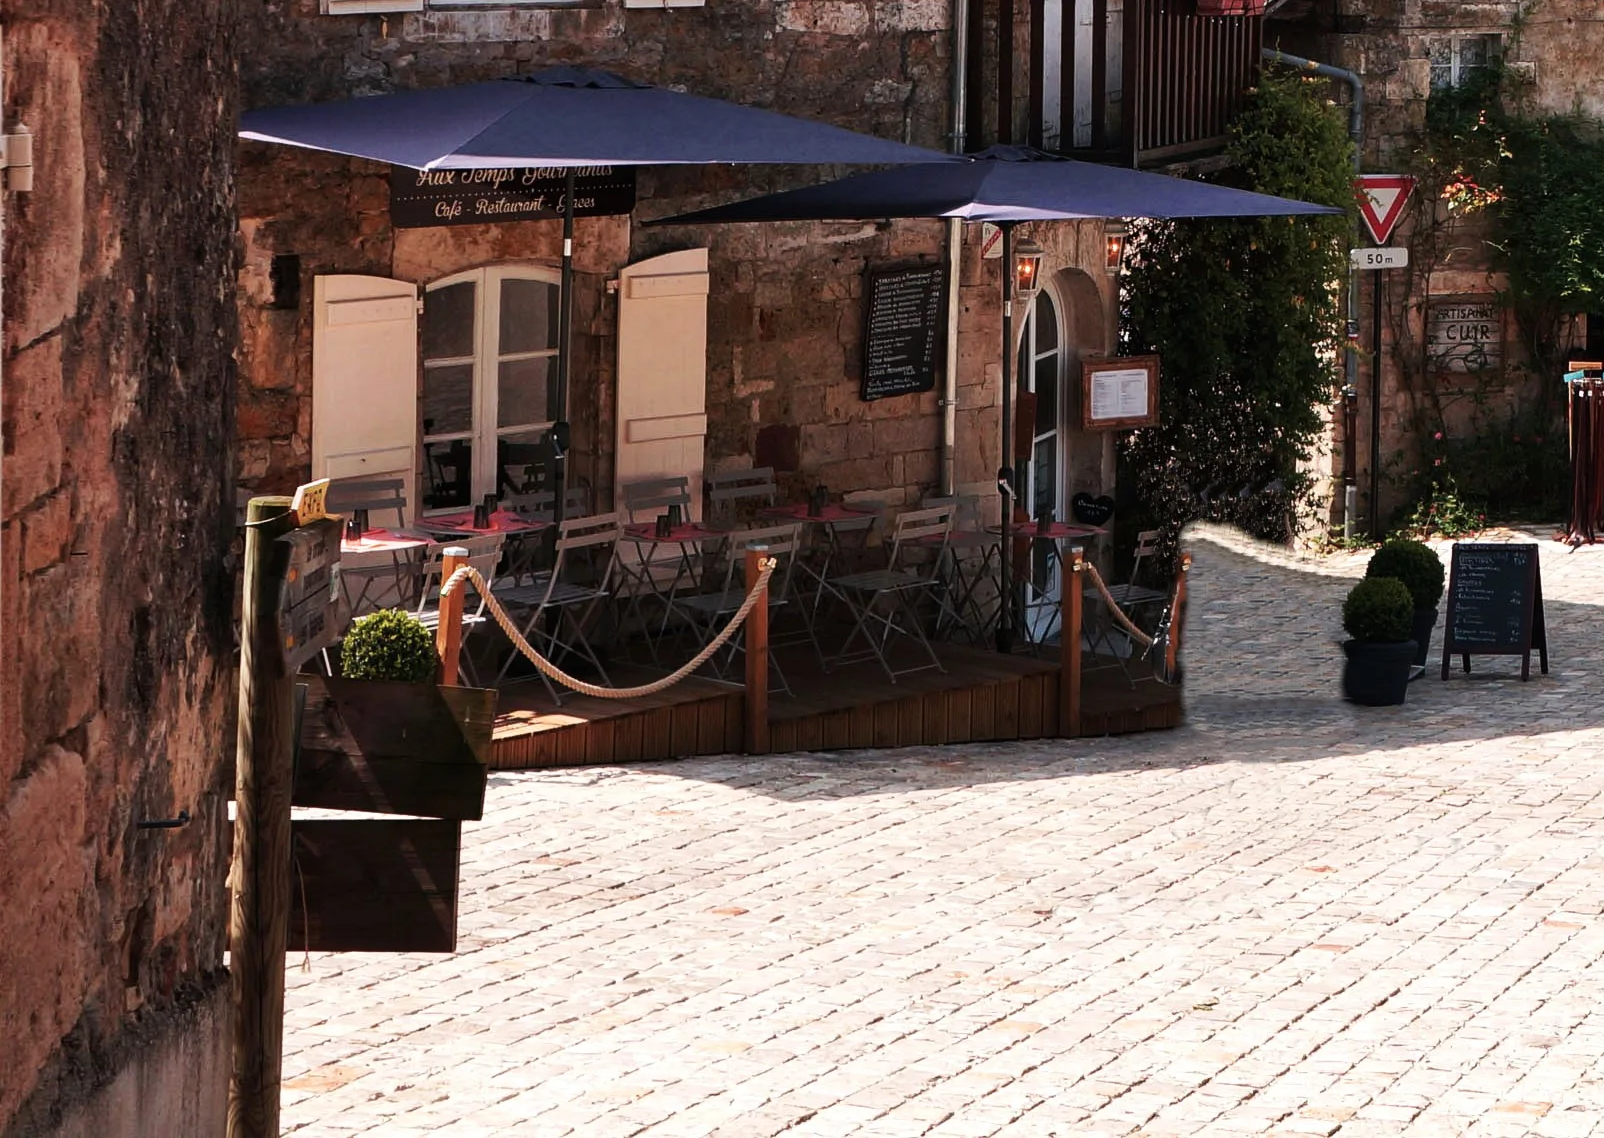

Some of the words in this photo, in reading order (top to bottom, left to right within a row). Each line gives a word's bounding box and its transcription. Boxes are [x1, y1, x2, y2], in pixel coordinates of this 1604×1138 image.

[416, 169, 456, 187] Aux
[435, 199, 463, 220] Café
[475, 195, 545, 215] Restaurant
[556, 193, 596, 213] Gaces
[1446, 324, 1490, 341] CUIR
